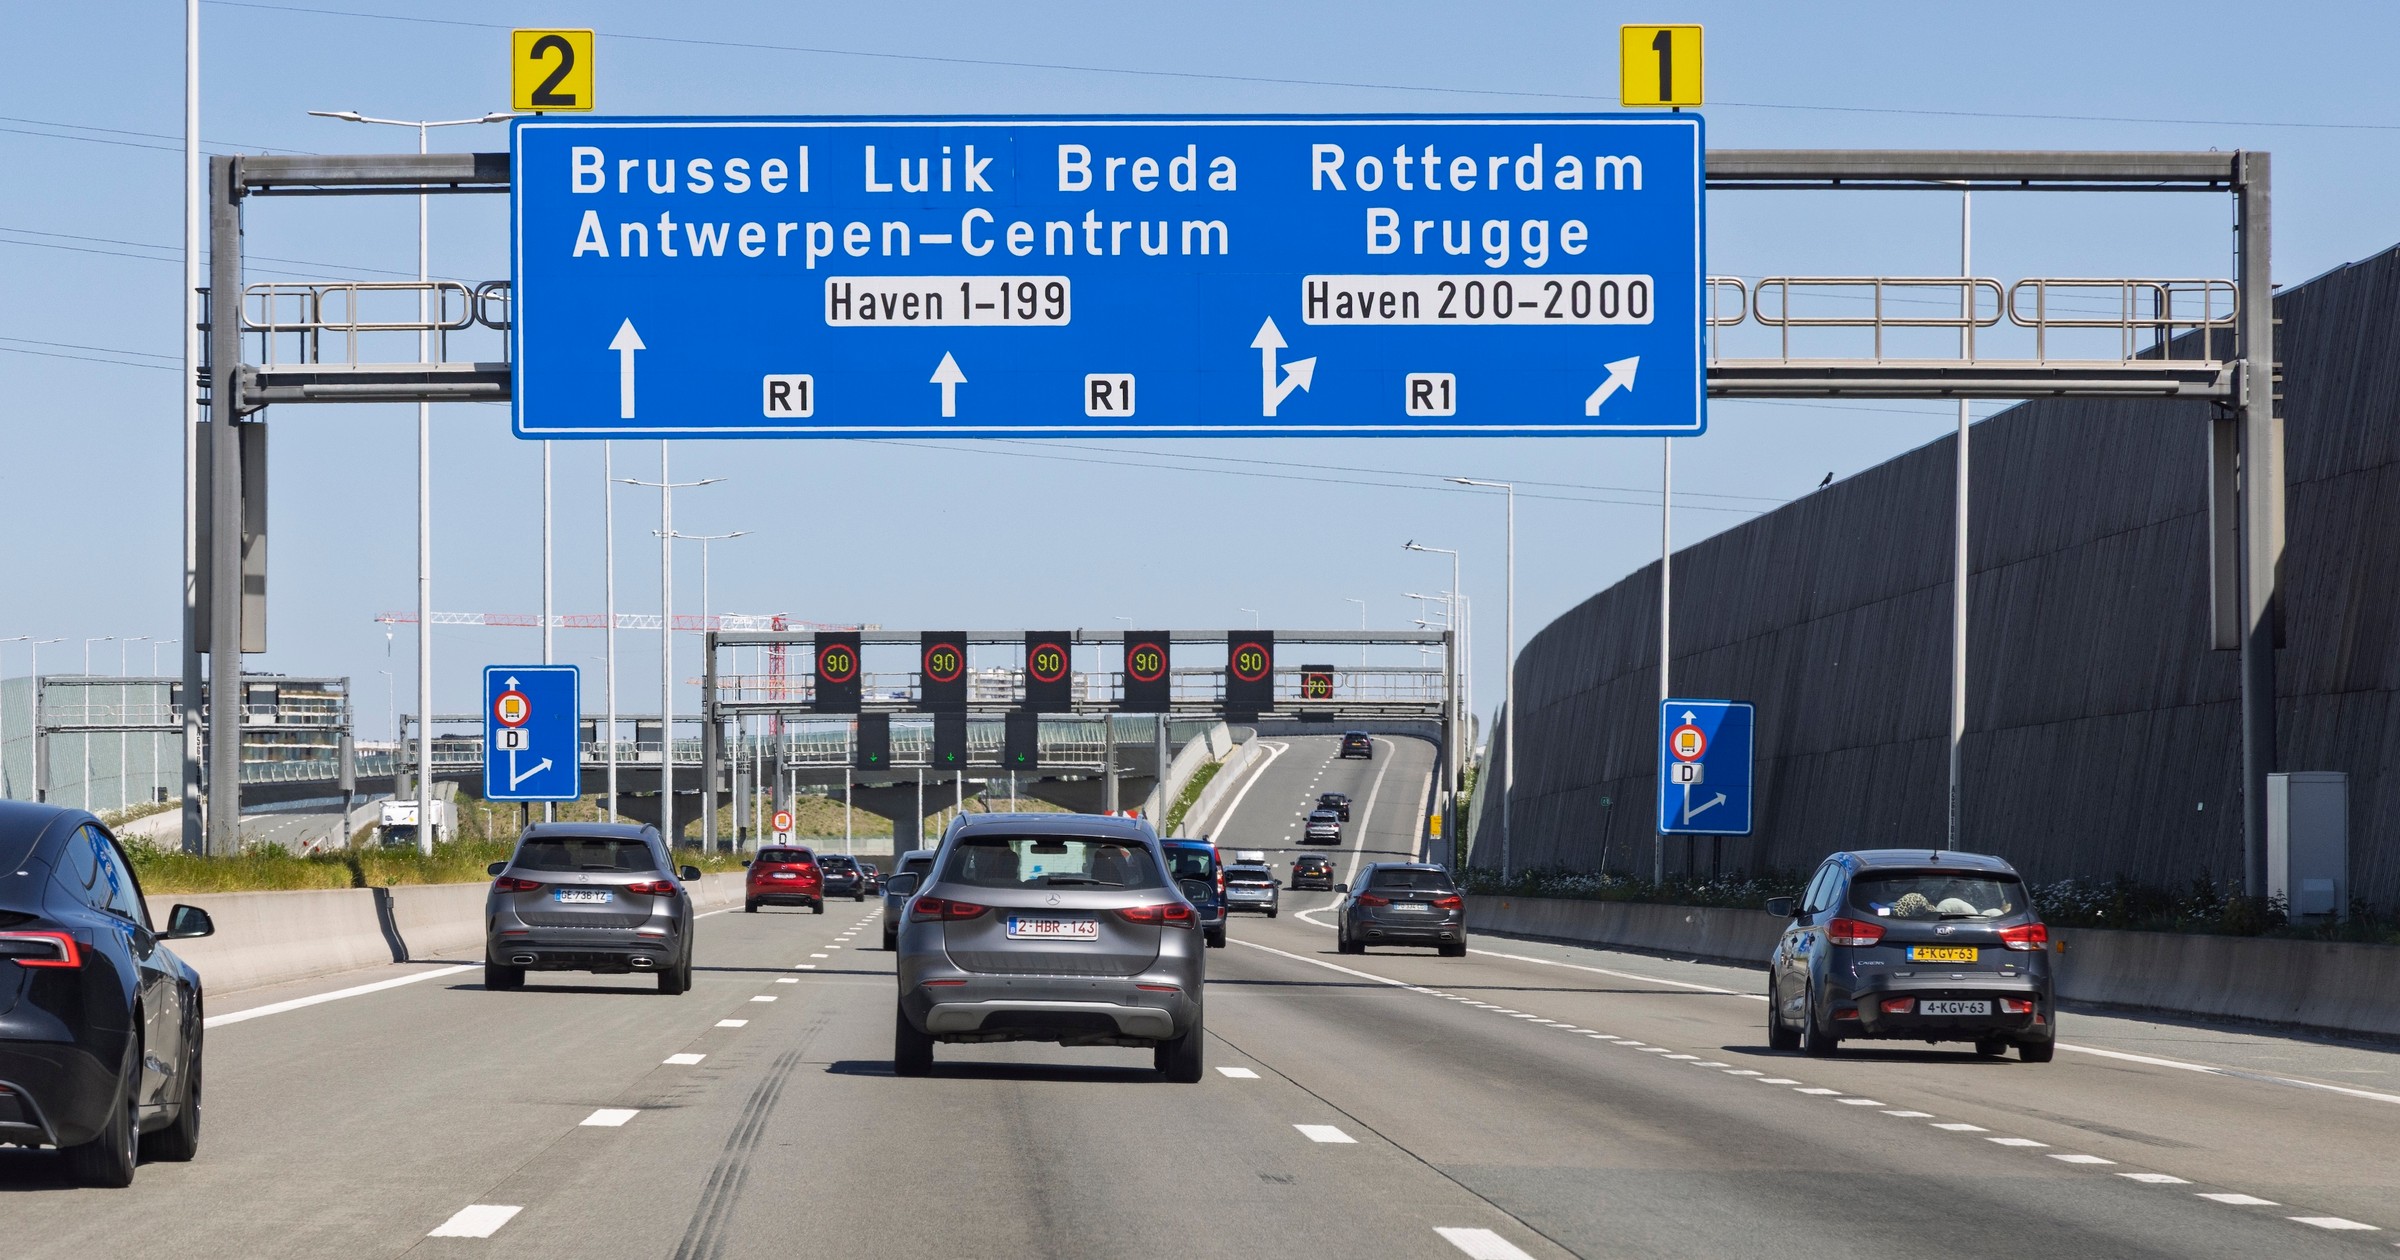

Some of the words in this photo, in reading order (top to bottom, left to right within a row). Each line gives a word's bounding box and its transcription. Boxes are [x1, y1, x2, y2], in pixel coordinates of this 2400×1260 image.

[530, 35, 577, 106] 2
[1652, 30, 1673, 102] 1
[571, 145, 809, 194] Brussel
[865, 144, 994, 193] Luik
[1058, 144, 1237, 192] Breda
[1312, 143, 1643, 192] Rotterdam
[572, 207, 1229, 270] Antwerpen-Centrum
[1366, 207, 1589, 269] Brugge
[831, 282, 942, 321] Haven
[960, 281, 1065, 320] 1-199
[1308, 281, 1419, 319] Haven
[1437, 280, 1648, 319] 200-2000
[769, 380, 808, 411] R1
[1091, 380, 1130, 411] R1
[1412, 379, 1450, 410] R1
[827, 654, 849, 672] 90
[933, 653, 955, 672] 90
[1037, 653, 1059, 672] 90
[1136, 653, 1158, 672] 90
[1240, 653, 1262, 671] 90
[506, 731, 519, 748] D
[1681, 765, 1694, 782] D
[778, 833, 787, 845] D
[1936, 927, 1951, 935] KIA
[1917, 948, 1973, 960] 4-KGV-63
[1927, 1002, 1985, 1014] 4-KGV-63
